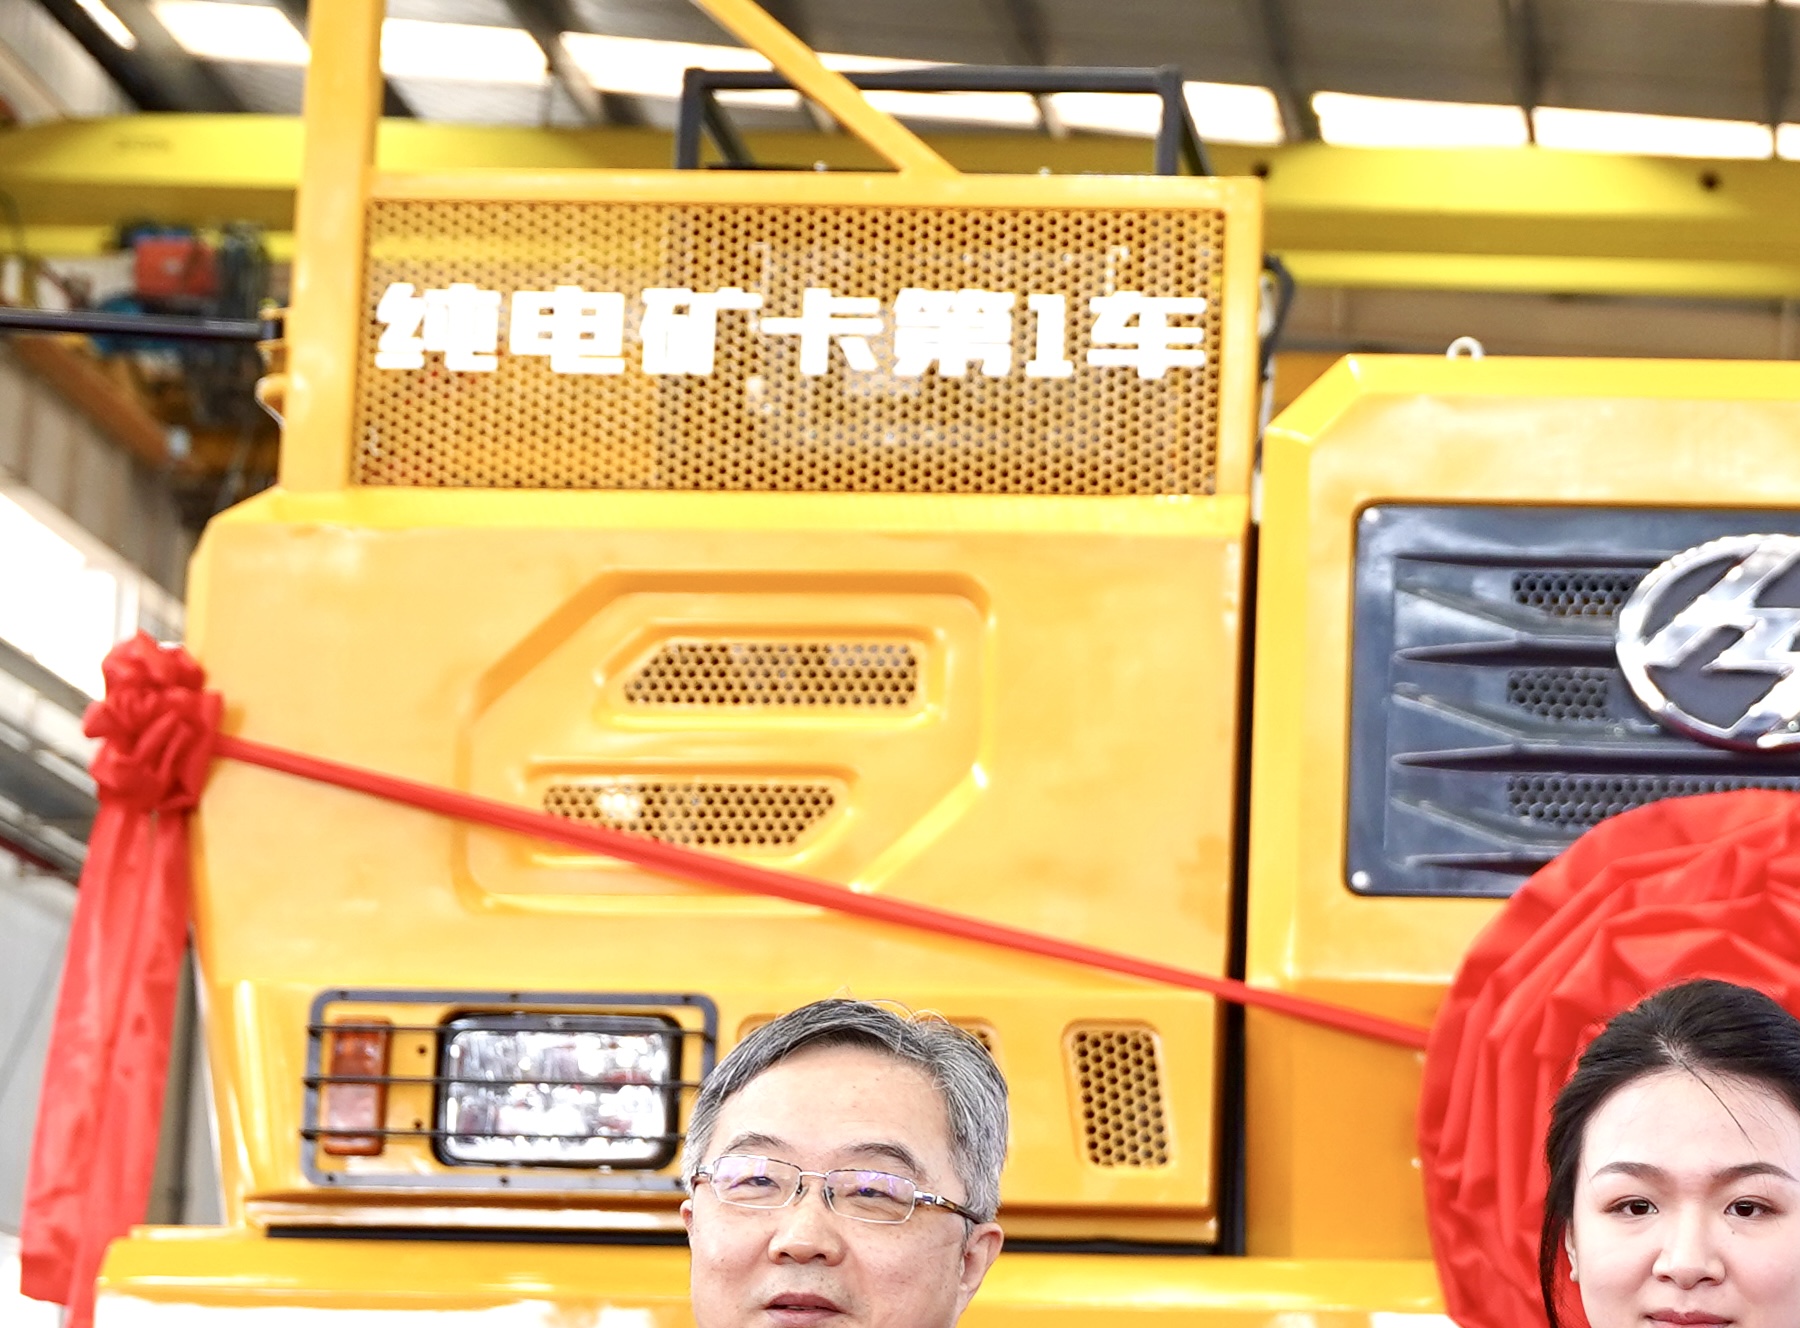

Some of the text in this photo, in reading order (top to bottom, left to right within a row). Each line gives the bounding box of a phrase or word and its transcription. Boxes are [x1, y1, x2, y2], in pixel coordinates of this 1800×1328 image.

[374, 281, 1206, 379] 纯电矿卡第1车
